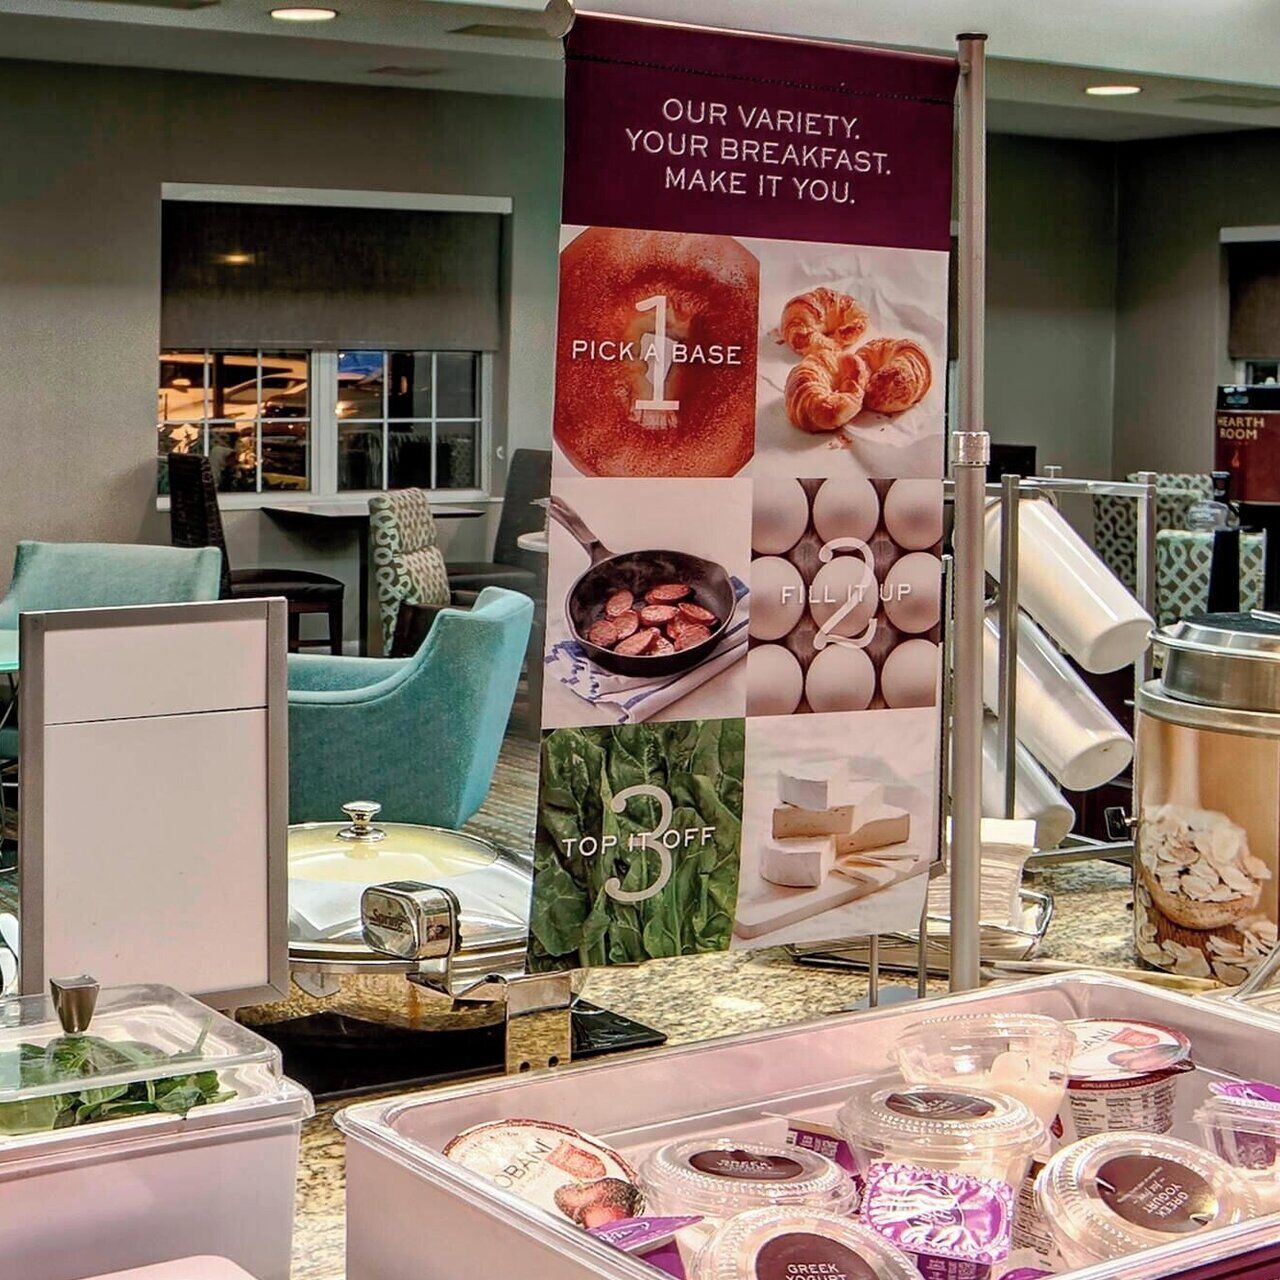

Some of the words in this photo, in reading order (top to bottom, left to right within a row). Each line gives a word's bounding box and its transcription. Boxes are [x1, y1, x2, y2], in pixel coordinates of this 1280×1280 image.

[663, 98, 728, 126] OUR
[738, 105, 860, 139] VARIETY.
[625, 128, 709, 158] YOUR
[721, 138, 891, 175] BREAKFAST.
[664, 166, 747, 195] MAKE
[758, 174, 783, 197] IT
[792, 177, 855, 204] YOU.
[572, 340, 634, 361] PICK
[644, 344, 660, 362] A
[672, 344, 742, 365] BASE
[635, 295, 680, 410] 1
[1217, 416, 1265, 428] HEARTH
[1220, 428, 1258, 440] ROOM
[781, 585, 836, 604] FILL
[848, 584, 867, 602] IT
[879, 583, 911, 601] UP
[813, 537, 878, 650] 2
[562, 835, 618, 857] TOP
[629, 832, 652, 852] IT
[662, 826, 716, 849] OFF
[605, 784, 673, 901] 3
[1142, 1183, 1182, 1214] YOGURT
[1155, 1191, 1189, 1218] GREEK
[787, 1263, 839, 1274] GREEK
